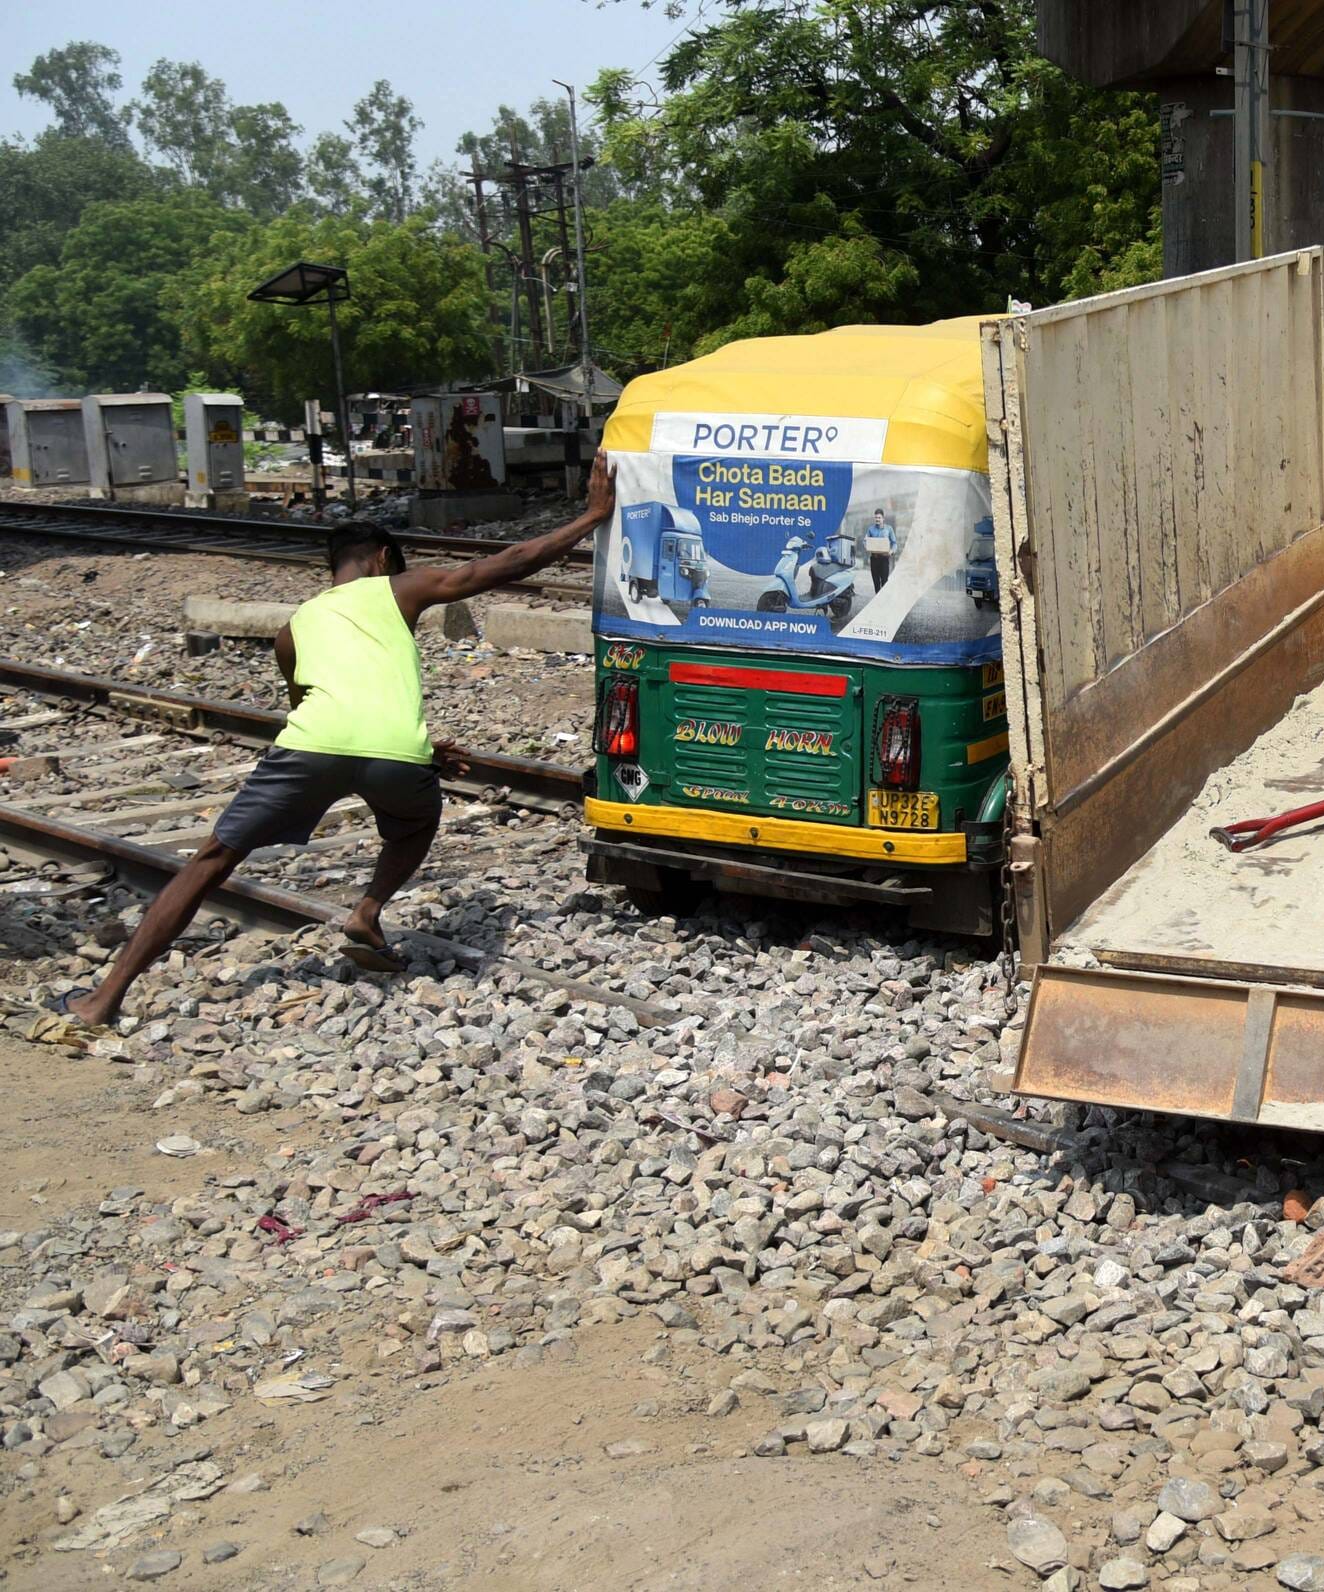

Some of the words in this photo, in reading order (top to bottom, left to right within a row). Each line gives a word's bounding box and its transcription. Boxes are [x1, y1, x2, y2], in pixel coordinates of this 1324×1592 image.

[693, 423, 821, 454] PORTER
[698, 462, 764, 485] Chota
[769, 464, 824, 487] Bada
[696, 486, 734, 508] Har
[738, 488, 827, 511] Samaan
[709, 511, 729, 523] Sab
[731, 512, 760, 526] Bhejo
[761, 514, 795, 527] Porter
[797, 515, 811, 527] Se
[699, 615, 762, 630] DOWNLOAD
[765, 620, 788, 632] APP
[789, 621, 817, 635] NOW
[880, 792, 932, 810] UP32E
[879, 810, 930, 828] N9728
